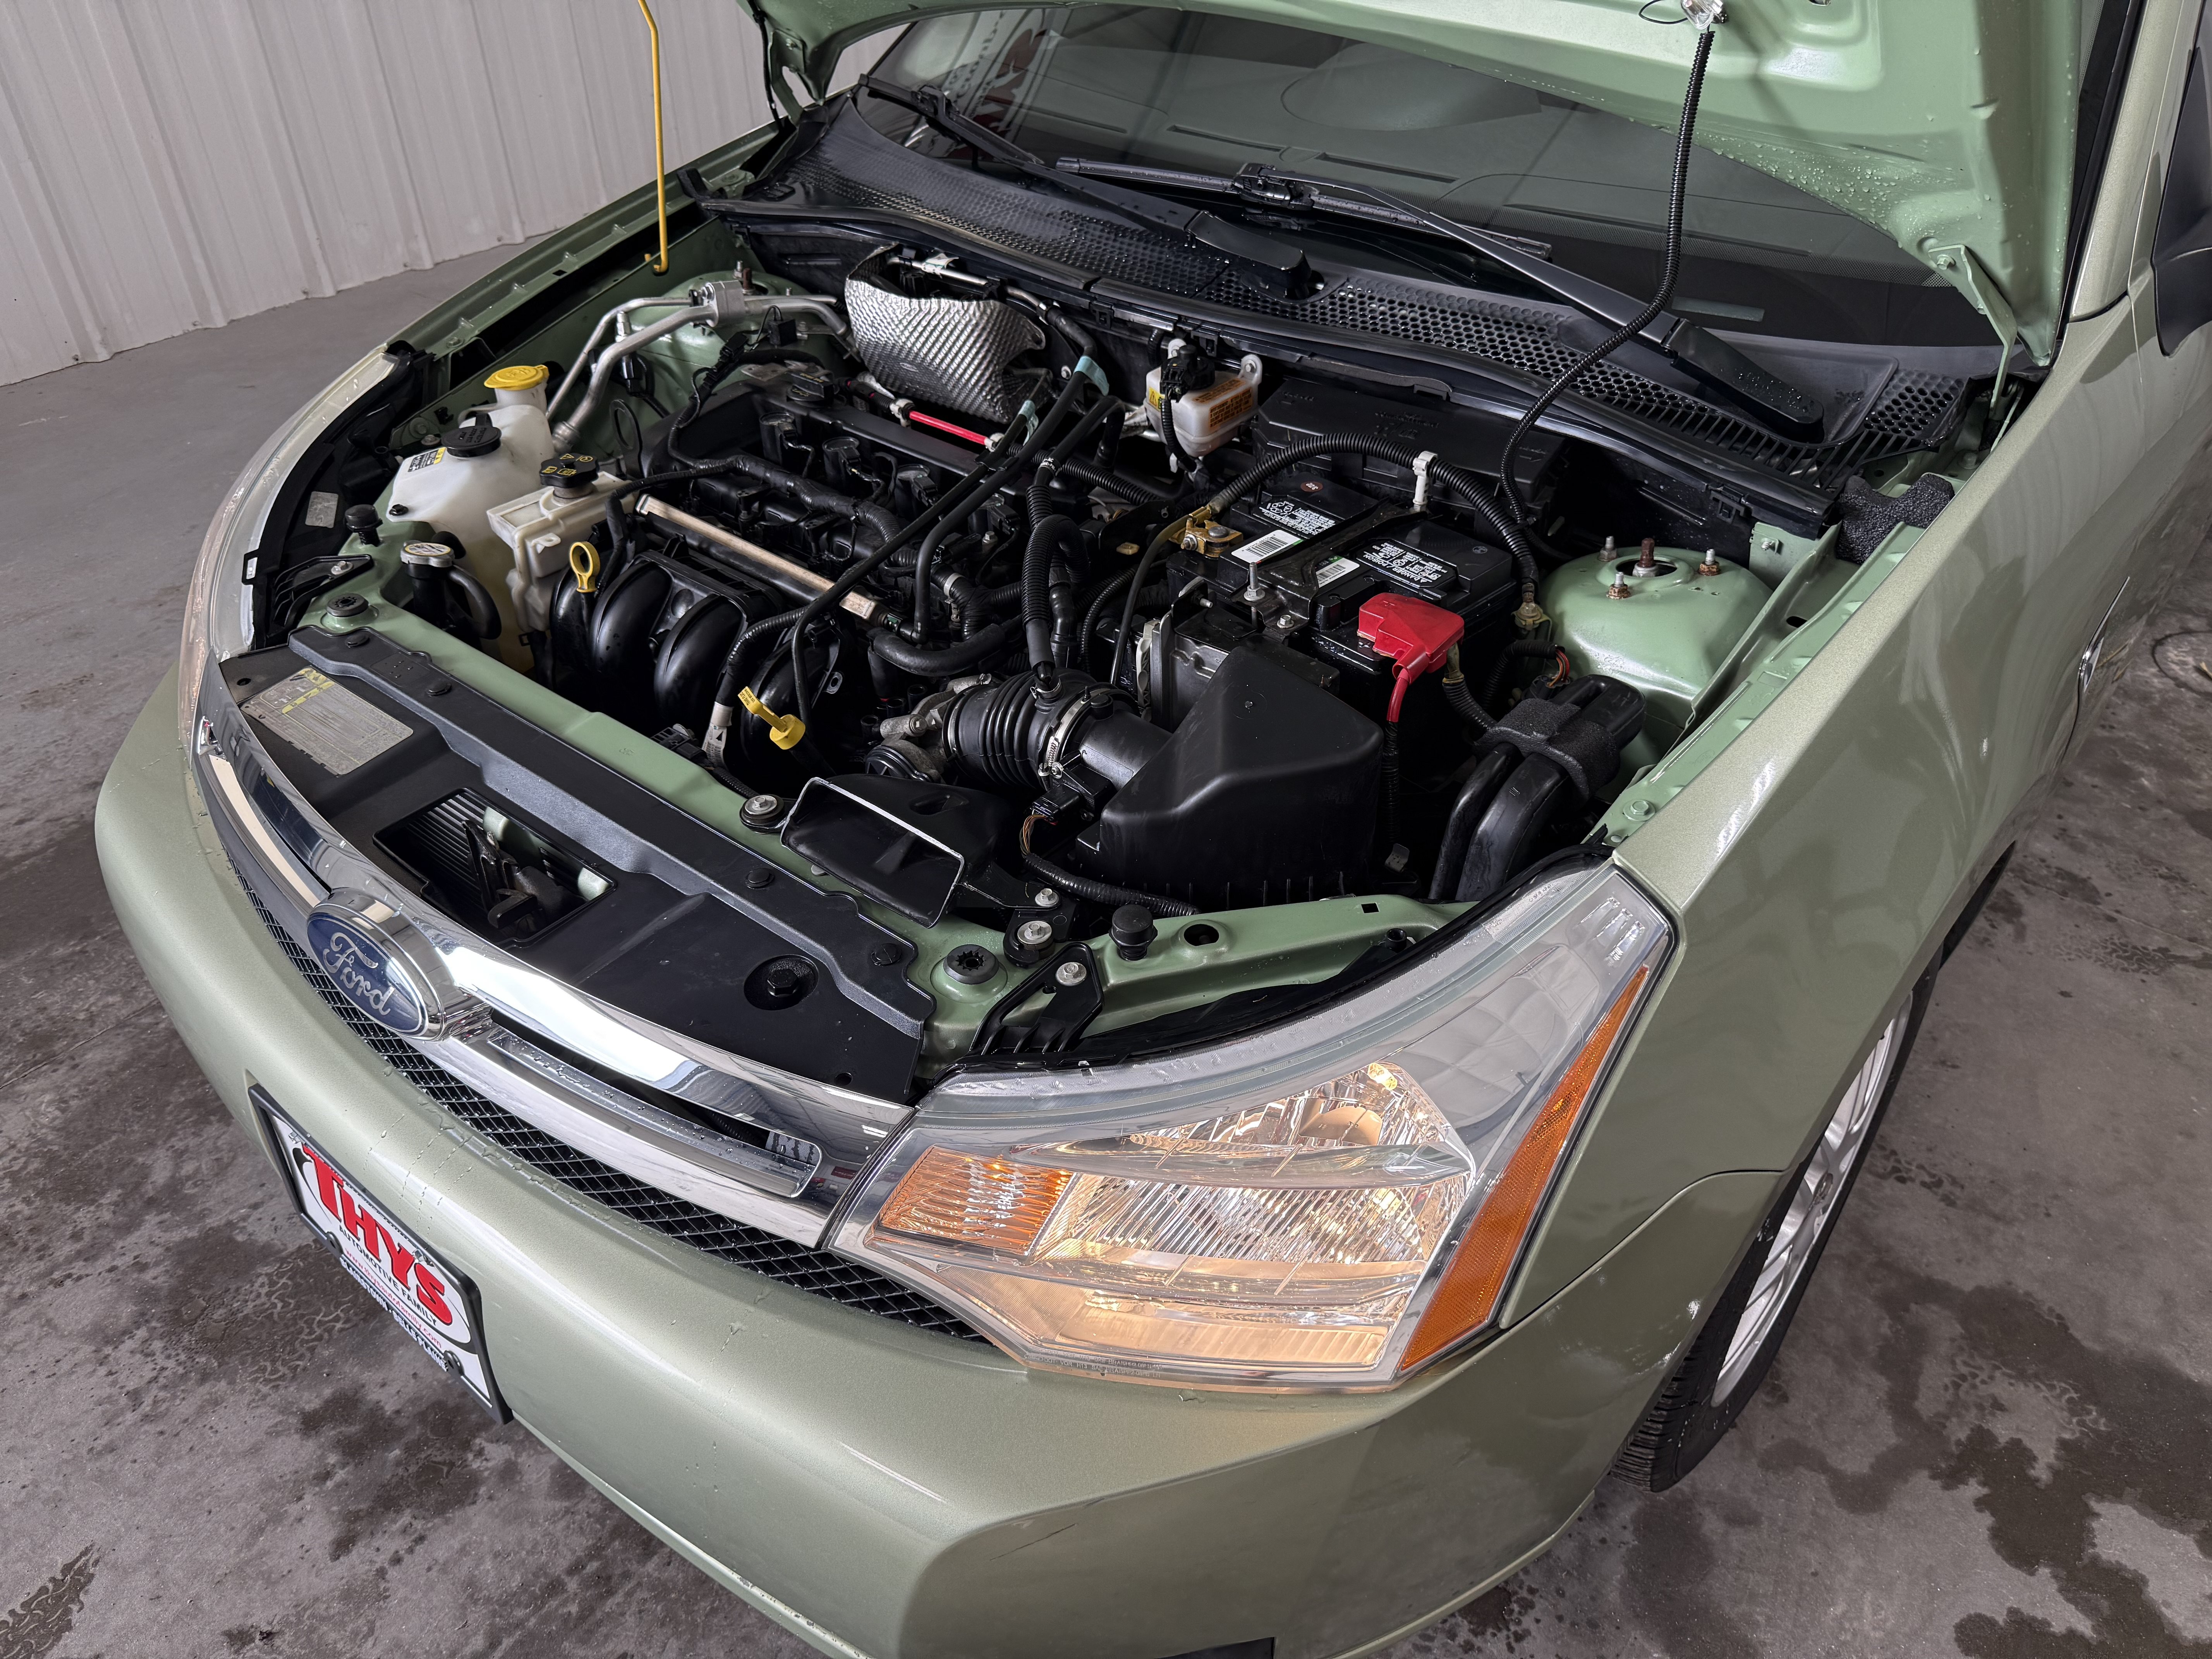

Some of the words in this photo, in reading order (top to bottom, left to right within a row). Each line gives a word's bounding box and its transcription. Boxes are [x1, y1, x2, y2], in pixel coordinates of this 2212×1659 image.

[323, 932, 395, 1015] Ford
[302, 1144, 453, 1326] THYS
[339, 1225, 399, 1291] AUTOMOTIVE
[402, 1287, 437, 1326] FAMILY
[345, 1248, 441, 1348] www.thysautofamily.com
